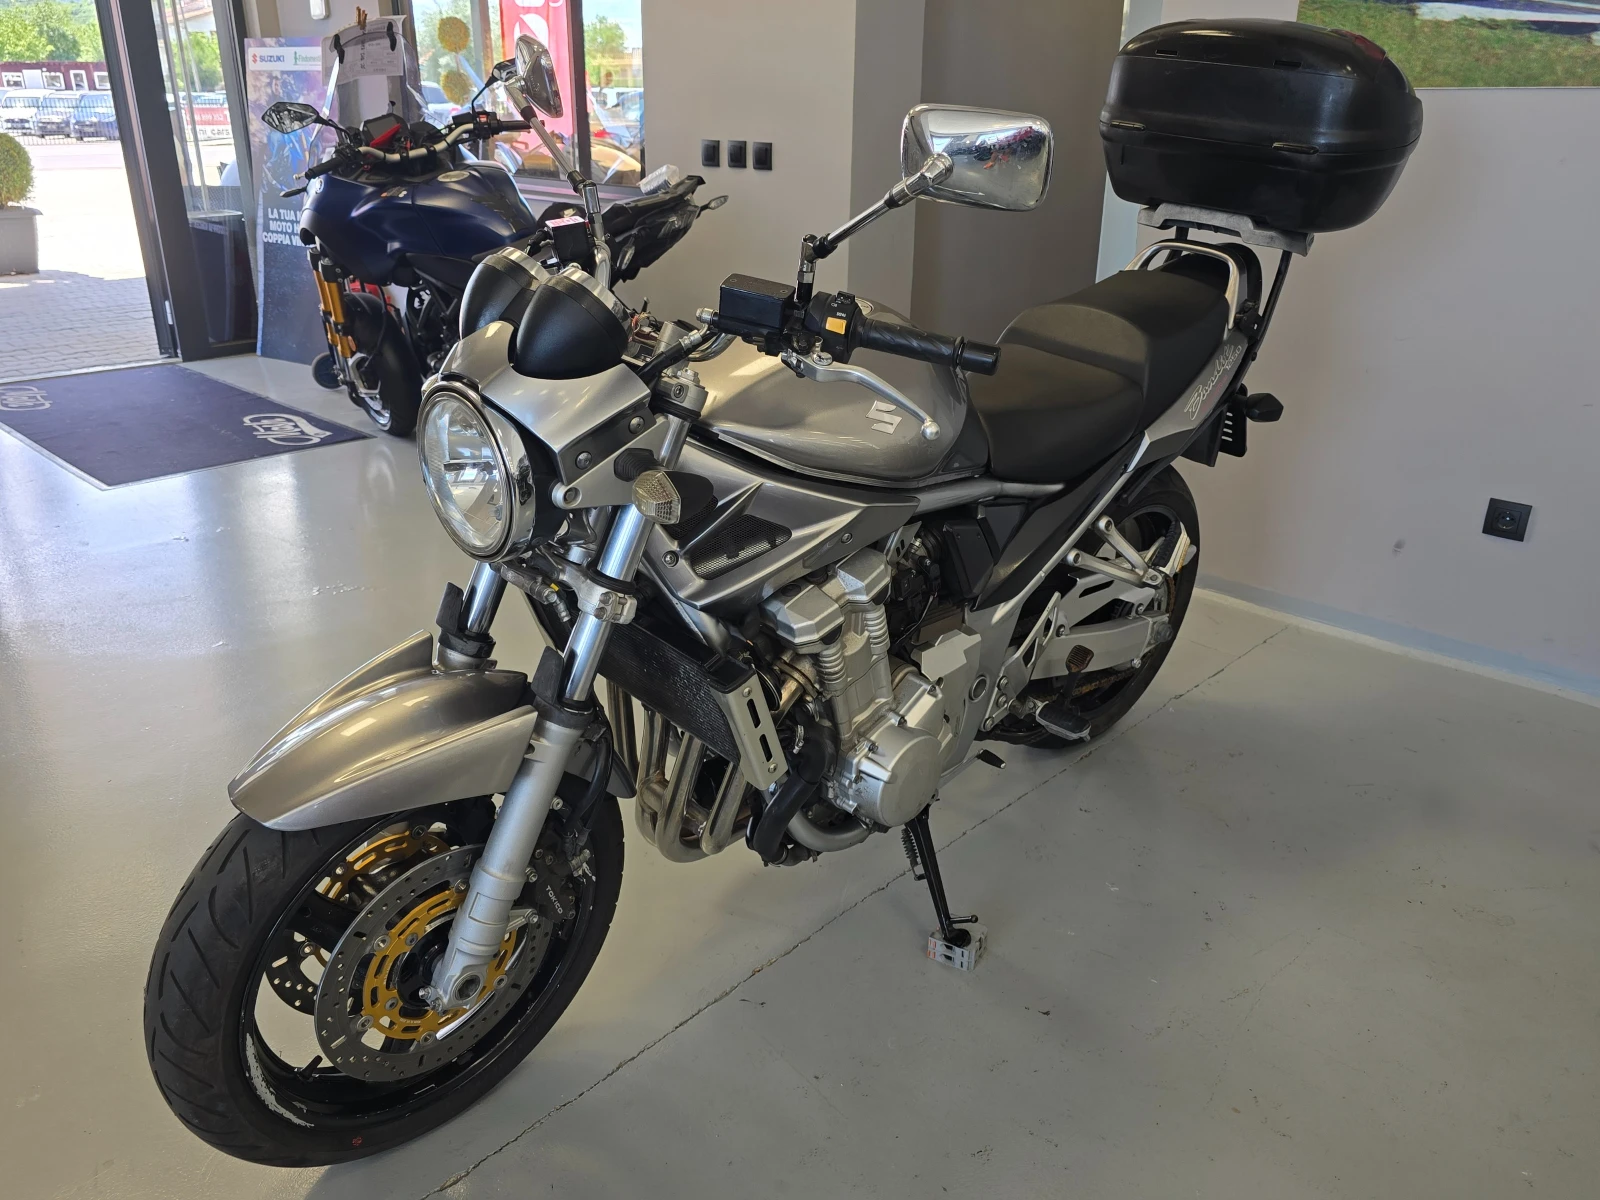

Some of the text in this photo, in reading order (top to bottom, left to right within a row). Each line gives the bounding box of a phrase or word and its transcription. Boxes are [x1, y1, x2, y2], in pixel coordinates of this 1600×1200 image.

[259, 55, 285, 63] SUZUKI
[268, 207, 279, 220] LA
[279, 209, 296, 221] TUA
[269, 220, 293, 233] MOTO
[262, 232, 291, 245] COPPIA
[545, 884, 563, 914] TOKICO
